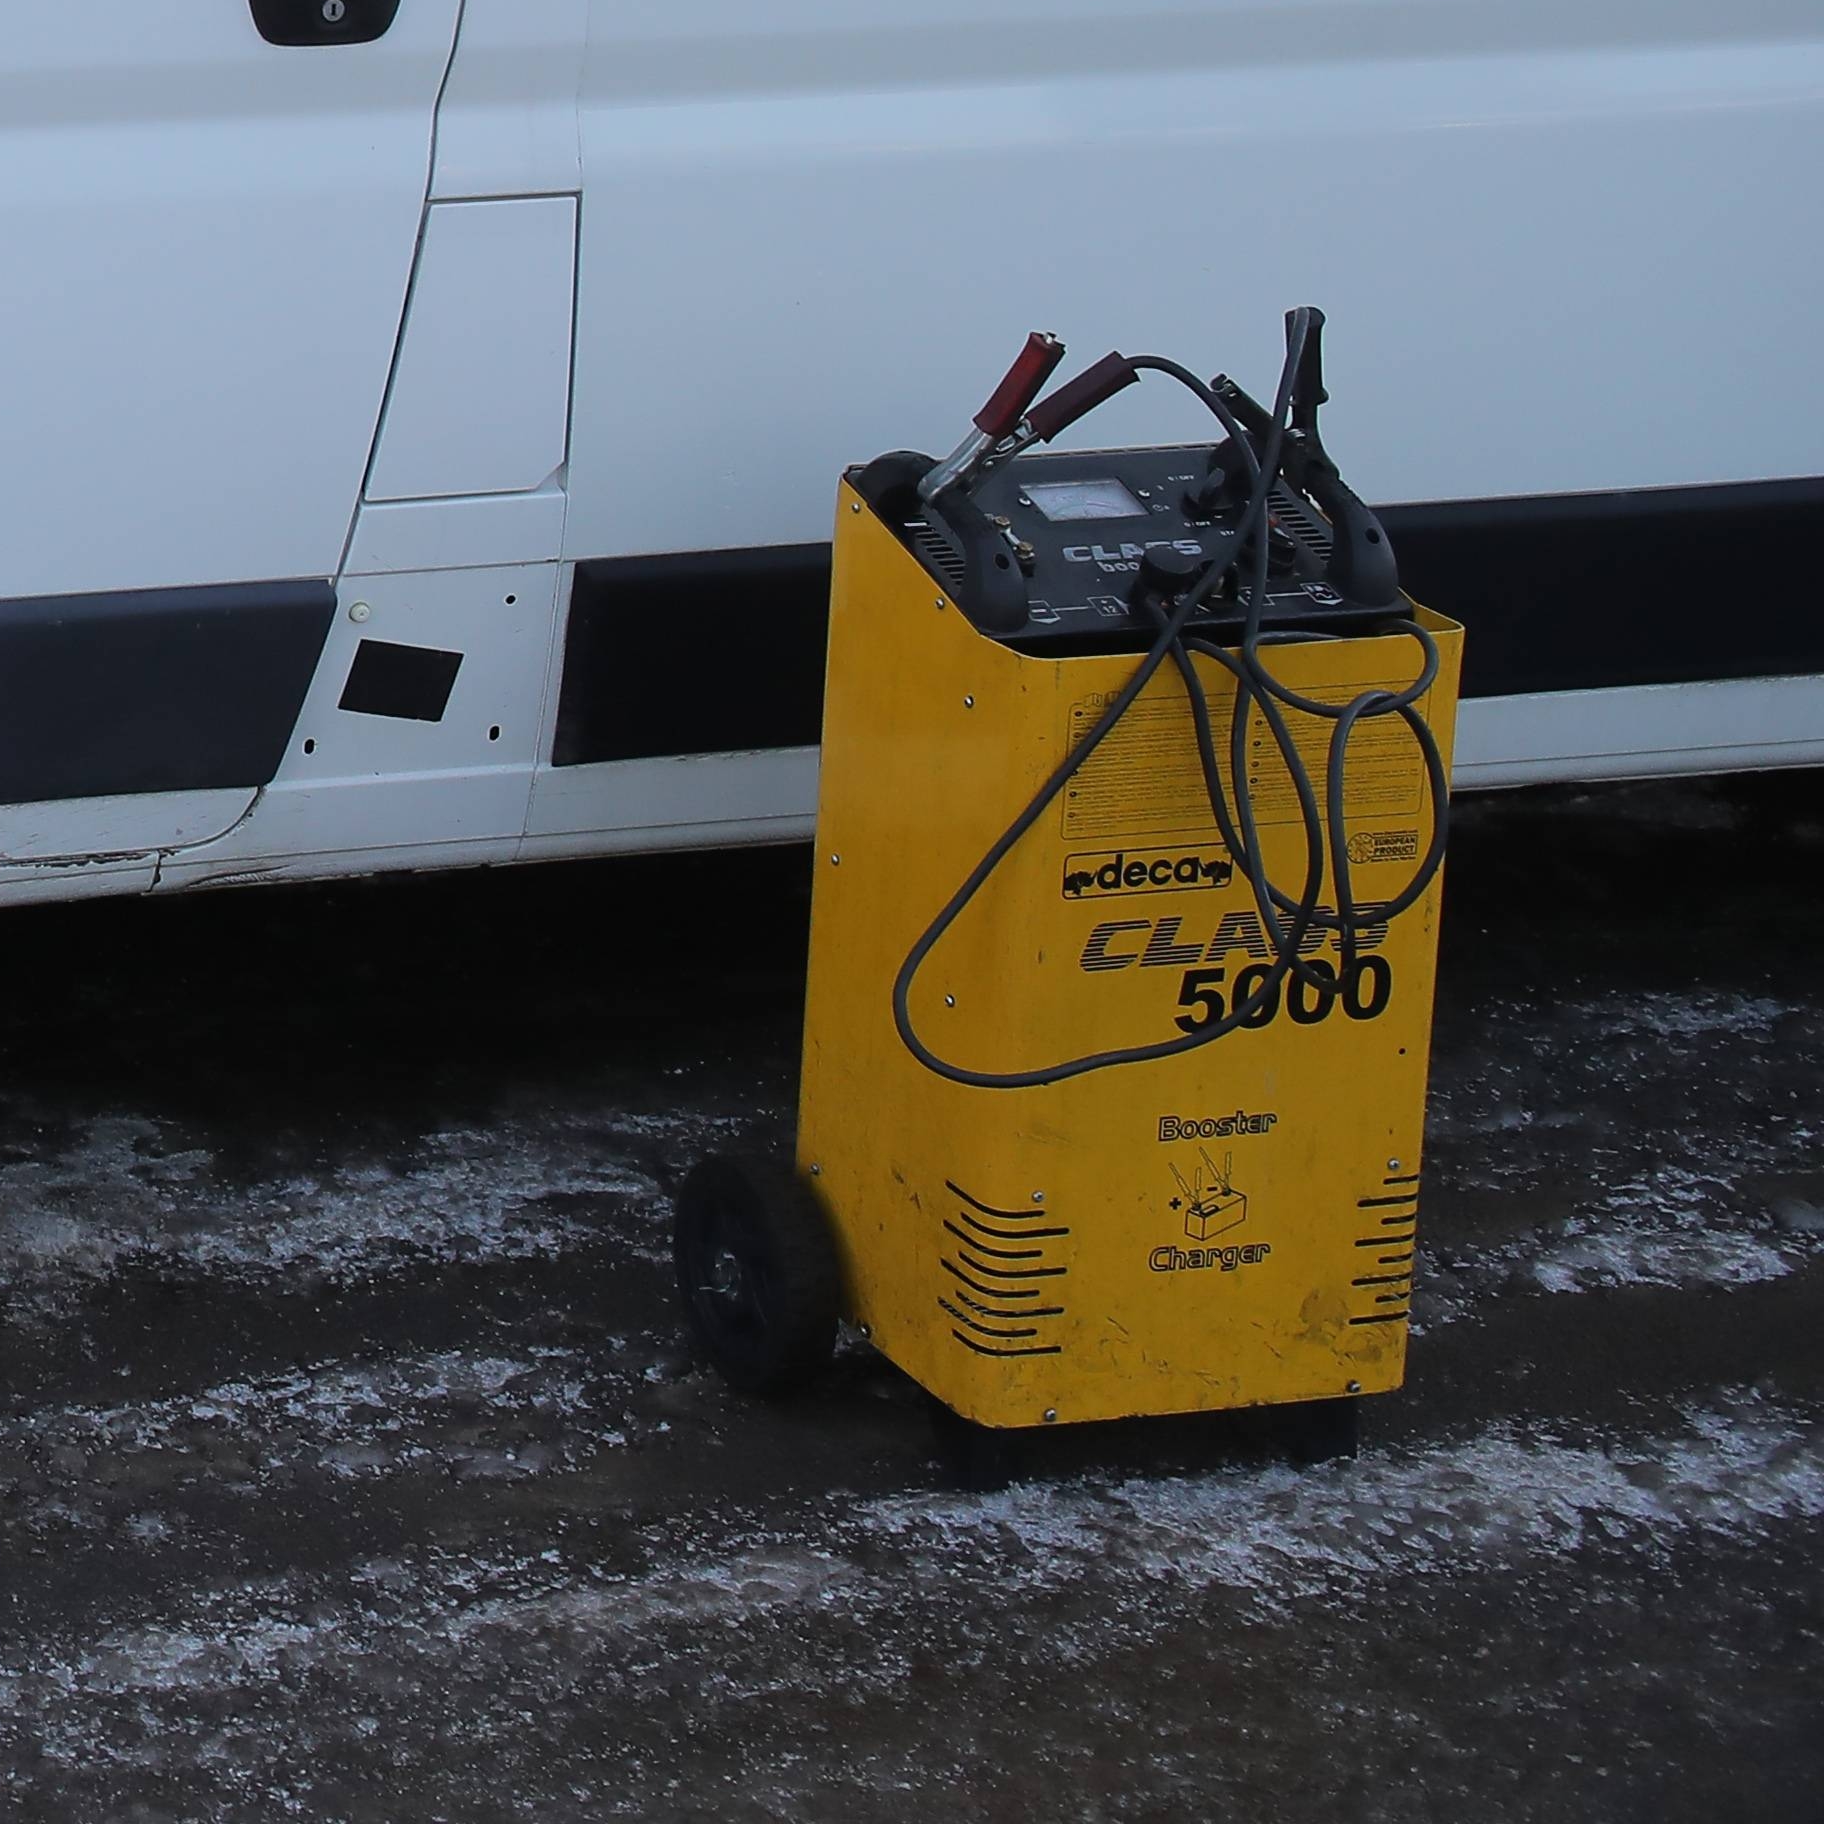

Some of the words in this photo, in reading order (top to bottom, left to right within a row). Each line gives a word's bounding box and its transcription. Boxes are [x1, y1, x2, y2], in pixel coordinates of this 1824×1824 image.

[1062, 539, 1203, 563] CLAS
[1374, 845, 1415, 856] PRODUCT
[1097, 855, 1201, 890] deca
[1175, 955, 1392, 1034] 5000
[1158, 1110, 1277, 1142] Booster
[1148, 1241, 1272, 1274] Charger
